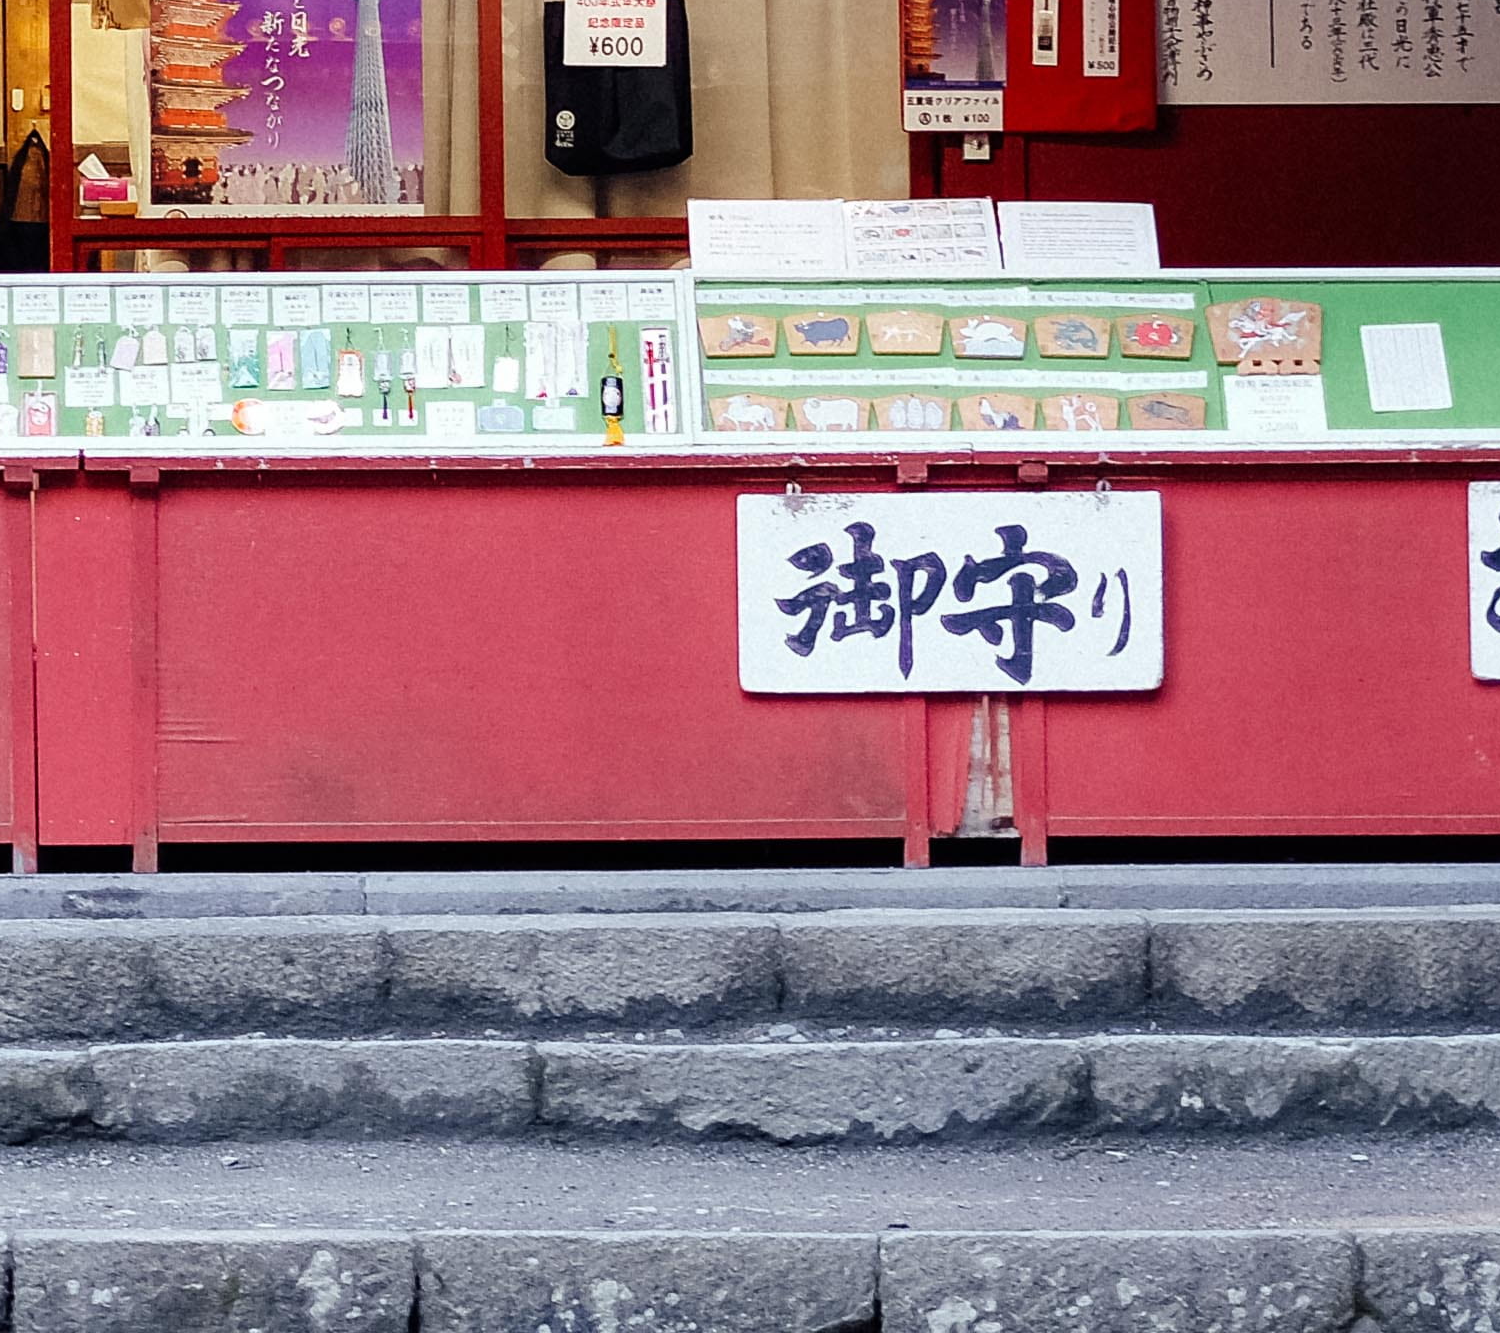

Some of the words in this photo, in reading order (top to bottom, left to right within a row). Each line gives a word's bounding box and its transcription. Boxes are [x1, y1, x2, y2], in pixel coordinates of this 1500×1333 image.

[259, 10, 286, 150] 新たなつながり
[588, 36, 644, 56] ¥600
[774, 520, 1131, 686] 御守り
